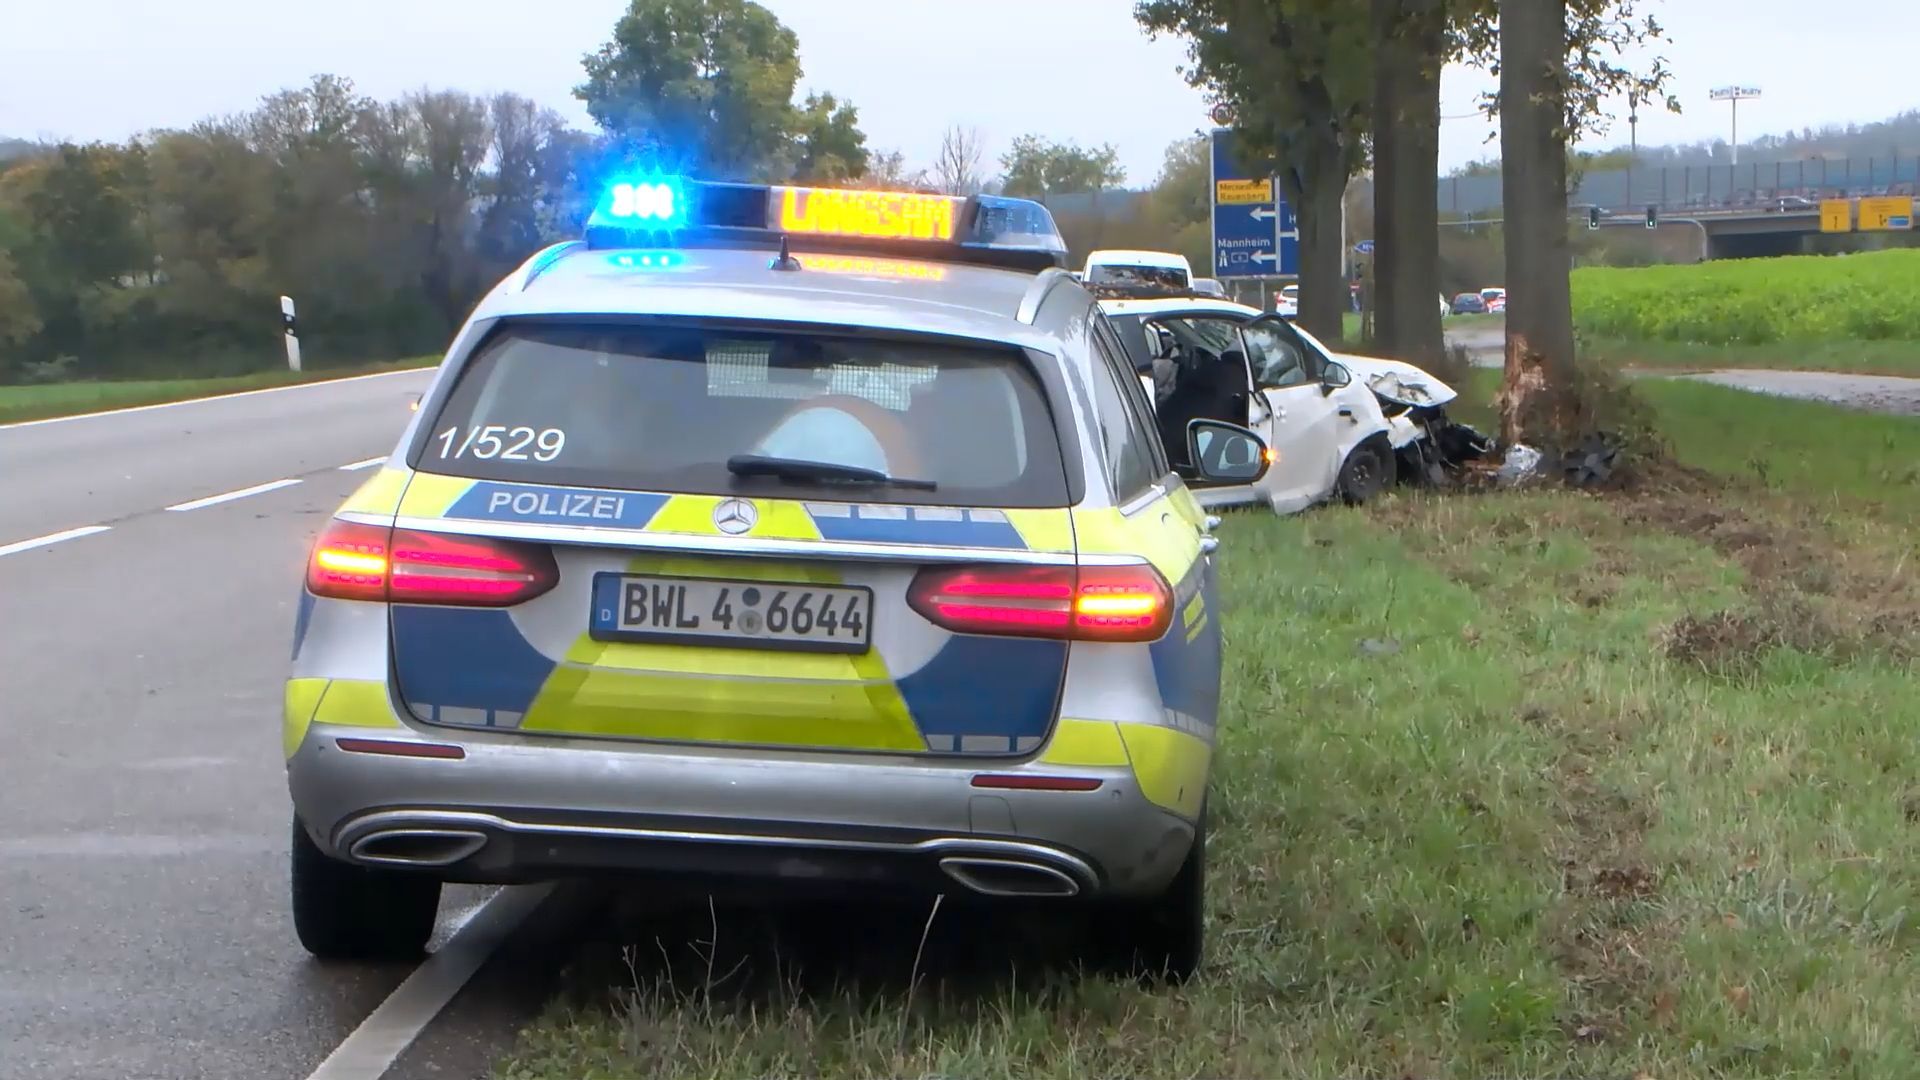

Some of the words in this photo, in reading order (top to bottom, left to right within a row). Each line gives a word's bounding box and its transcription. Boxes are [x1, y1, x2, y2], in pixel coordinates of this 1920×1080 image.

[782, 187, 953, 240] LANGSAM
[1217, 237, 1270, 248] Mannheim
[438, 425, 566, 462] 1/529
[488, 491, 626, 520] POLIZEI
[601, 608, 612, 622] D
[623, 583, 699, 628] BWL
[766, 591, 863, 637] 6644
